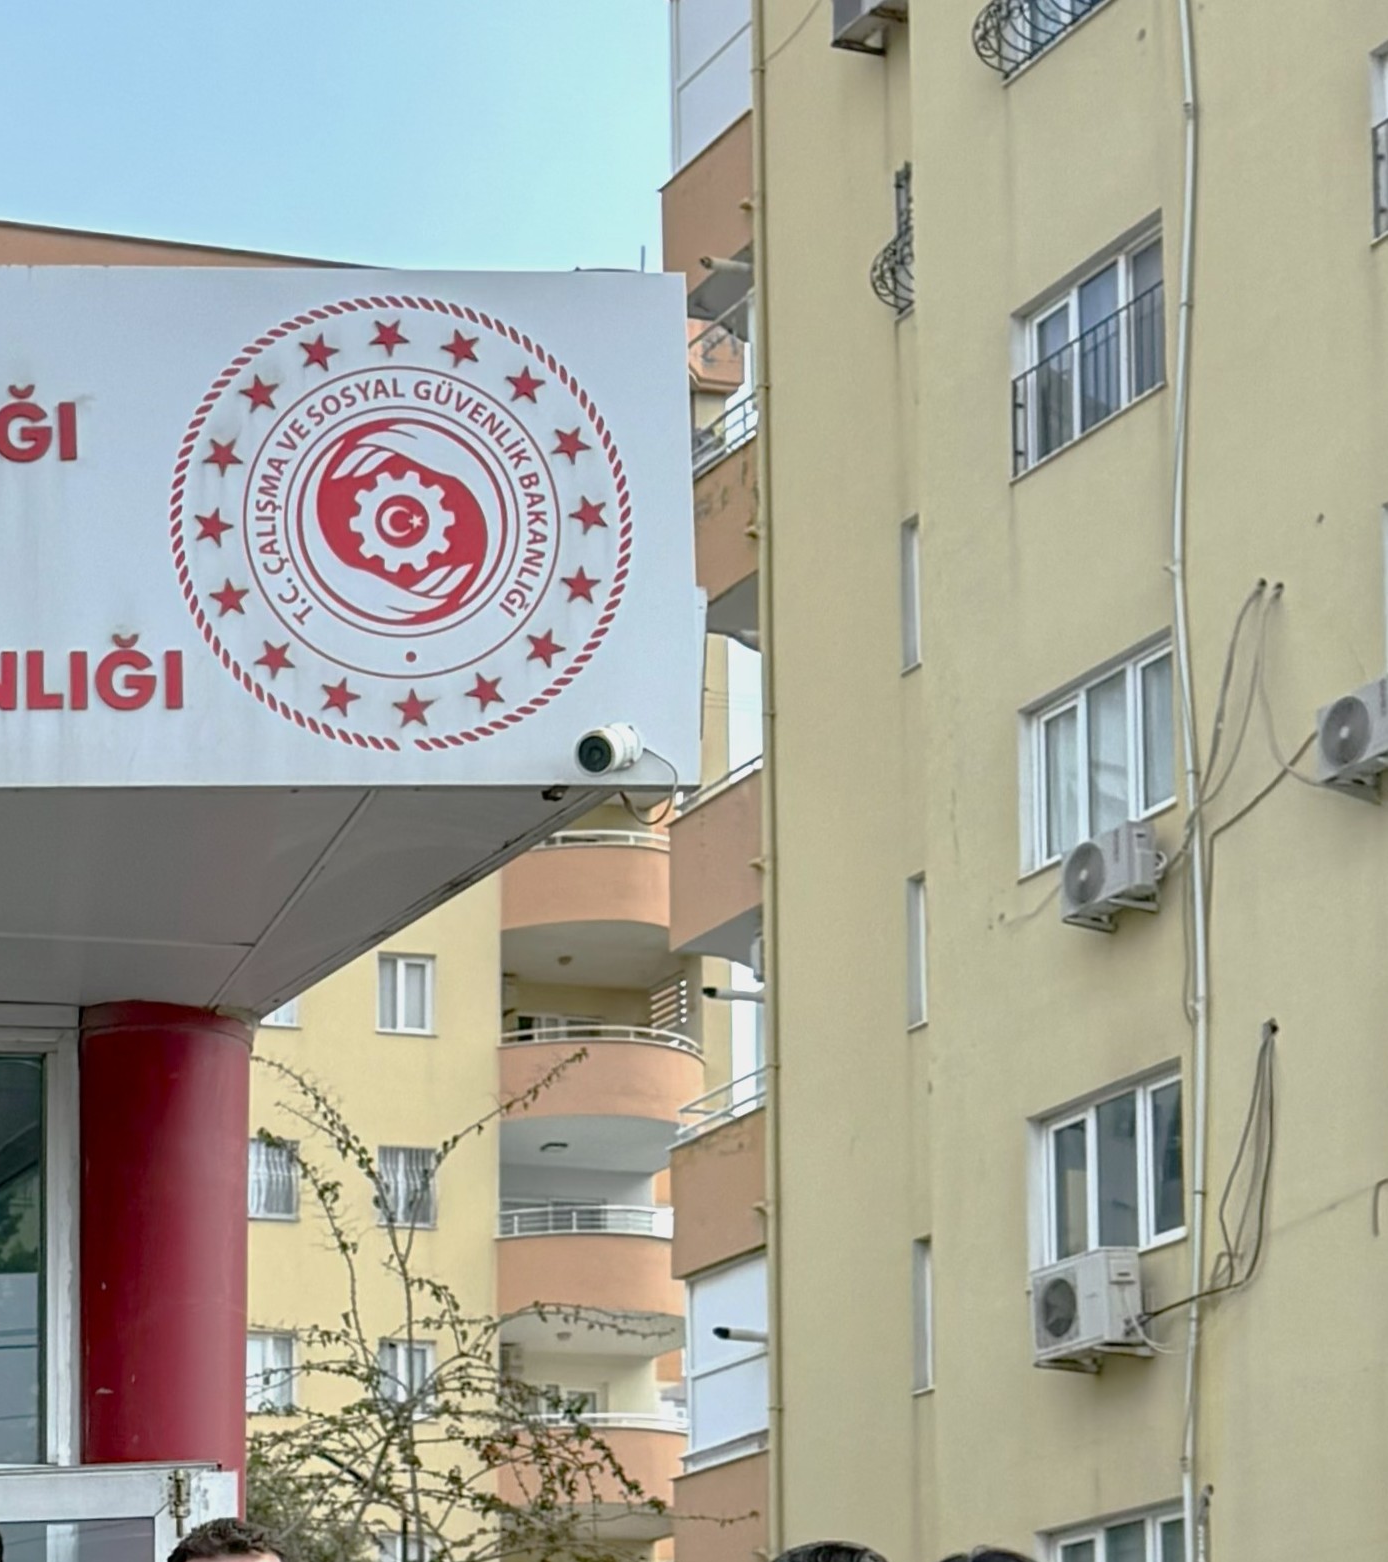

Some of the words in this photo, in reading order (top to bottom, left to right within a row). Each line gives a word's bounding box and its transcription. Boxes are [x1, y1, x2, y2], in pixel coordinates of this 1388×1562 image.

[276, 418, 311, 452] VE
[306, 377, 405, 427] SOSYAL
[413, 379, 532, 470] GÜVENLİK
[256, 456, 291, 576] ÇALIŞMA
[499, 471, 549, 618] BAKANLIĞI
[277, 578, 314, 627] T.C.
